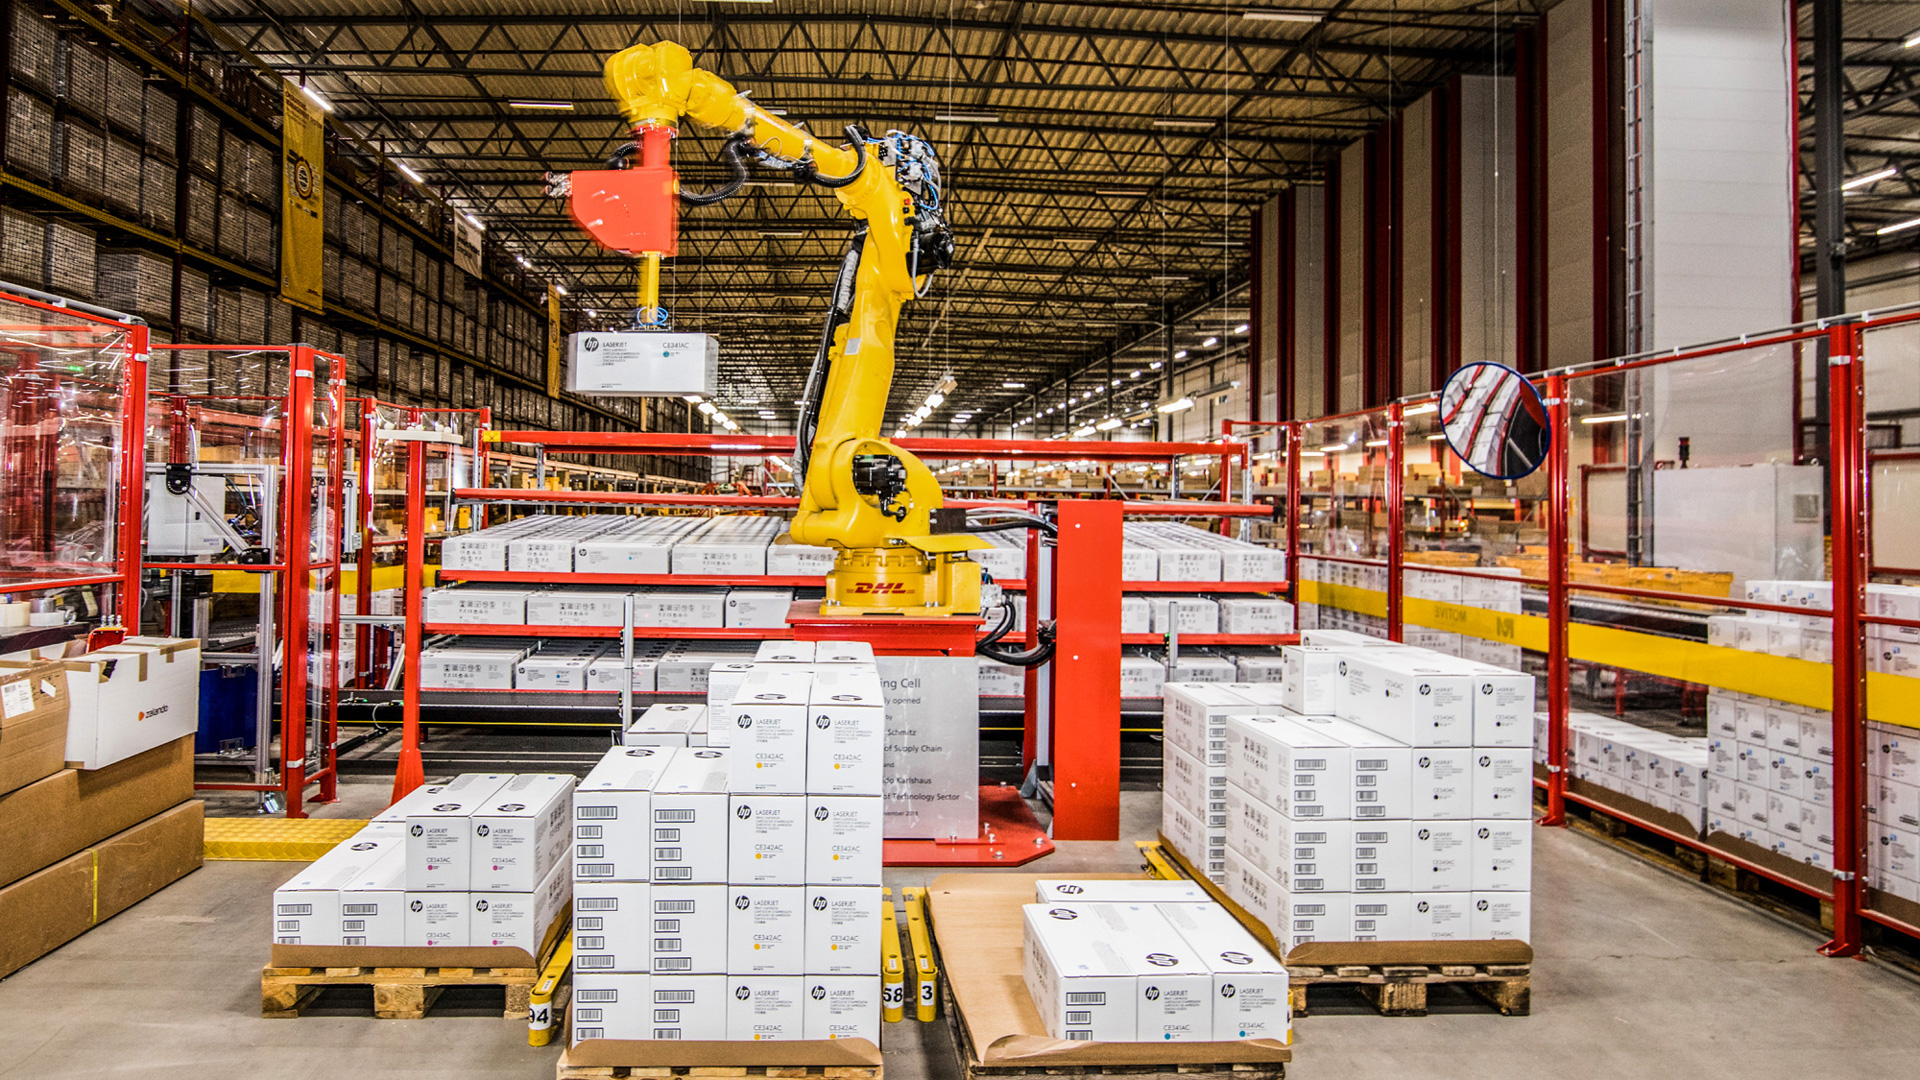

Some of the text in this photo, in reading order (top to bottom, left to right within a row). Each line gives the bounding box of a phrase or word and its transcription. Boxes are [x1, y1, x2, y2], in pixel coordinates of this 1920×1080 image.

[585, 337, 599, 352] hp
[854, 582, 907, 594] DHL
[880, 678, 921, 690] ing Cell
[145, 704, 168, 718] zalando
[738, 714, 752, 729] hp
[816, 715, 830, 729] hp
[887, 728, 917, 736] Schmitz
[884, 744, 942, 753] of Supply Chain
[893, 793, 934, 802] Technology
[737, 805, 751, 819] hp
[814, 806, 829, 821] hp
[411, 825, 423, 837] hp
[477, 825, 489, 837] hp
[411, 900, 423, 912] hp
[476, 900, 488, 912] hp
[735, 895, 750, 910] hp
[813, 896, 827, 911] hp
[736, 986, 750, 1000] hp
[811, 985, 826, 1000] hp
[883, 987, 903, 1002] 58
[922, 985, 933, 1000] 3
[1145, 986, 1159, 1001] hp
[1221, 983, 1235, 998] hp
